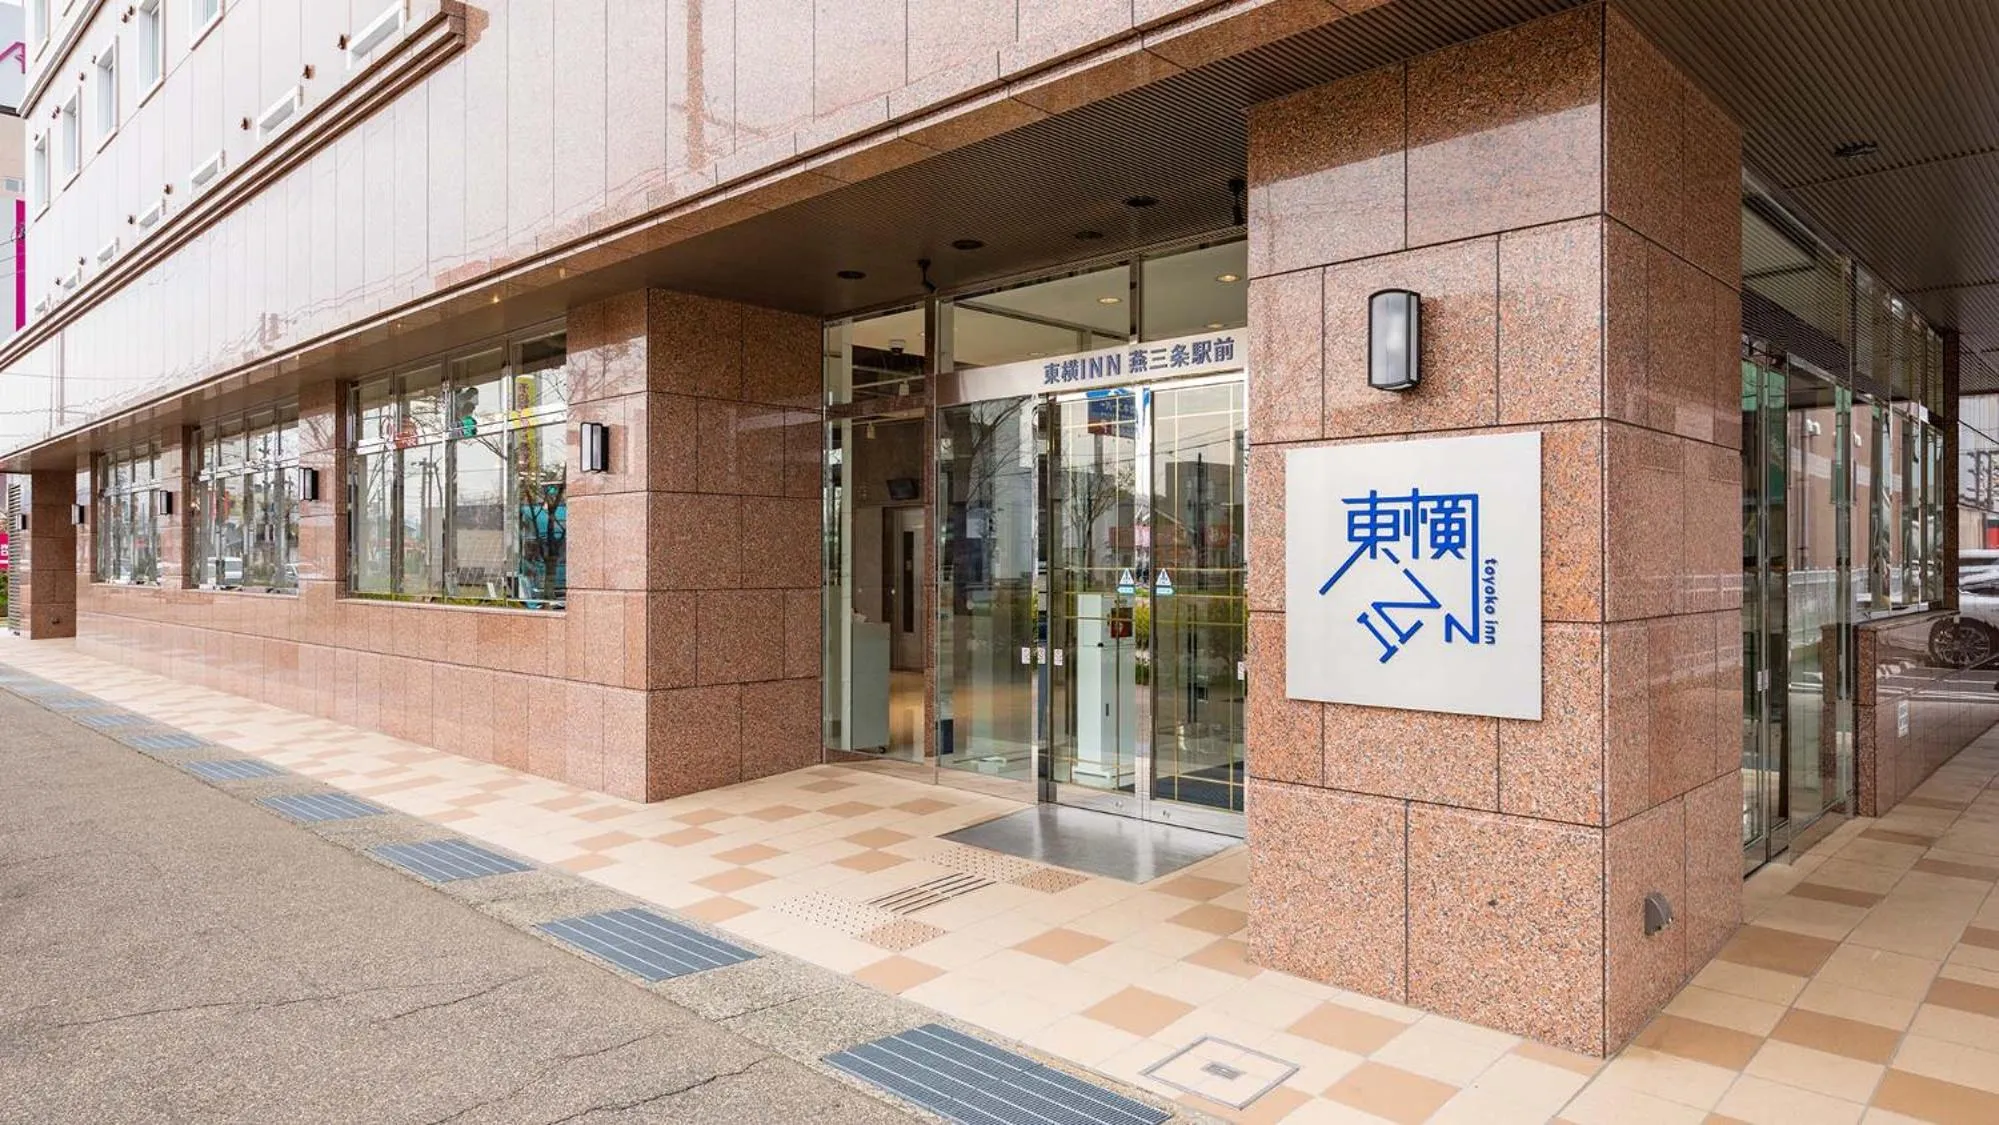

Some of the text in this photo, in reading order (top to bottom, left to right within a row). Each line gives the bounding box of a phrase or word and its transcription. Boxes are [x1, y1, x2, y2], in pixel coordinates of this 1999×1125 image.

[1043, 336, 1235, 385] 東横INN 燕三条駅前
[1481, 558, 1499, 645] toyoko inn
